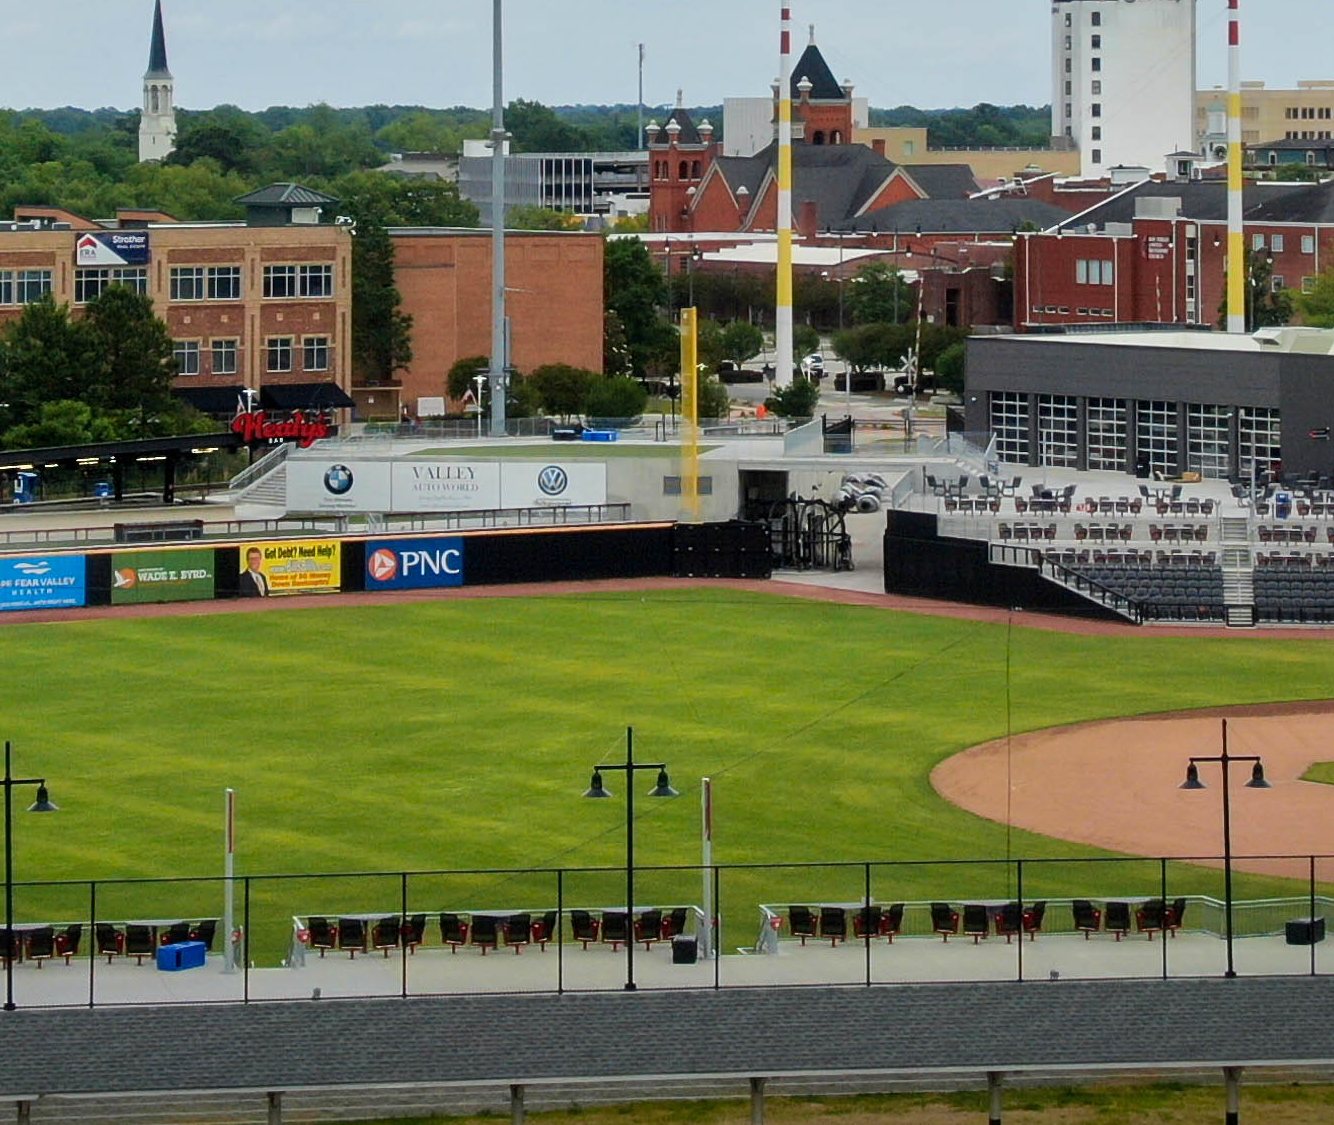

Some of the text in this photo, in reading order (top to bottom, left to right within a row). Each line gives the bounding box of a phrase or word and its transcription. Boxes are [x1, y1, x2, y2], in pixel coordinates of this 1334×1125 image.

[232, 411, 328, 448] Healy's
[412, 466, 475, 479] VALLEY
[412, 482, 480, 492] AUTO WORLD
[265, 544, 336, 559] Got Debt? Need Help?
[400, 549, 460, 576] PNC
[14, 578, 39, 587] FEAR
[40, 577, 76, 586] VALLEY
[138, 571, 167, 582] WADE
[181, 570, 206, 580] BYRD
